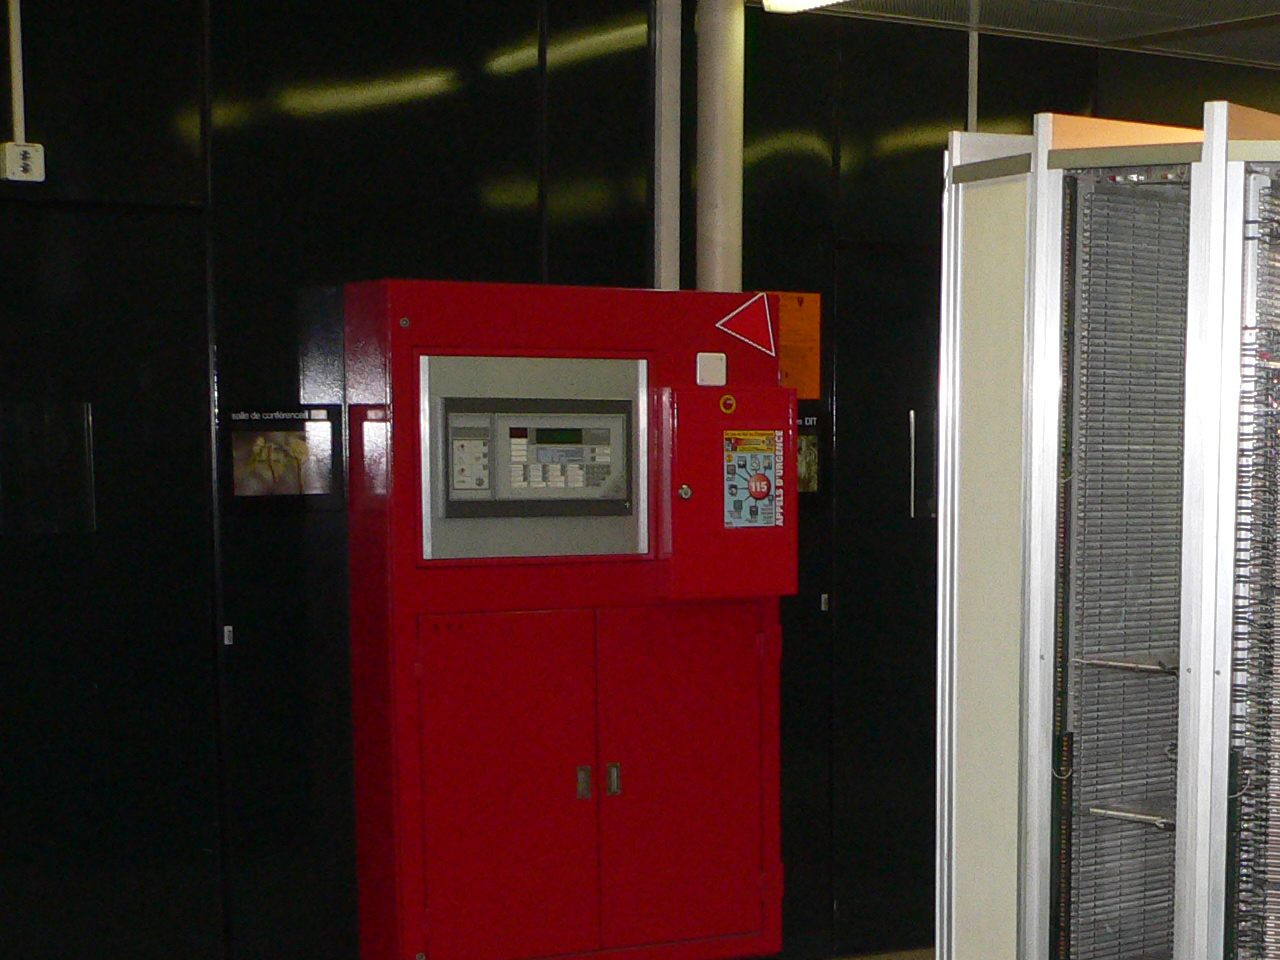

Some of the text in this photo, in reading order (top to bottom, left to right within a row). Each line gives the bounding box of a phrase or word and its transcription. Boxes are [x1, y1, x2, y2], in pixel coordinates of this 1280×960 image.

[751, 481, 768, 492] 115
[775, 430, 784, 527] APPELS D'URGENCE
